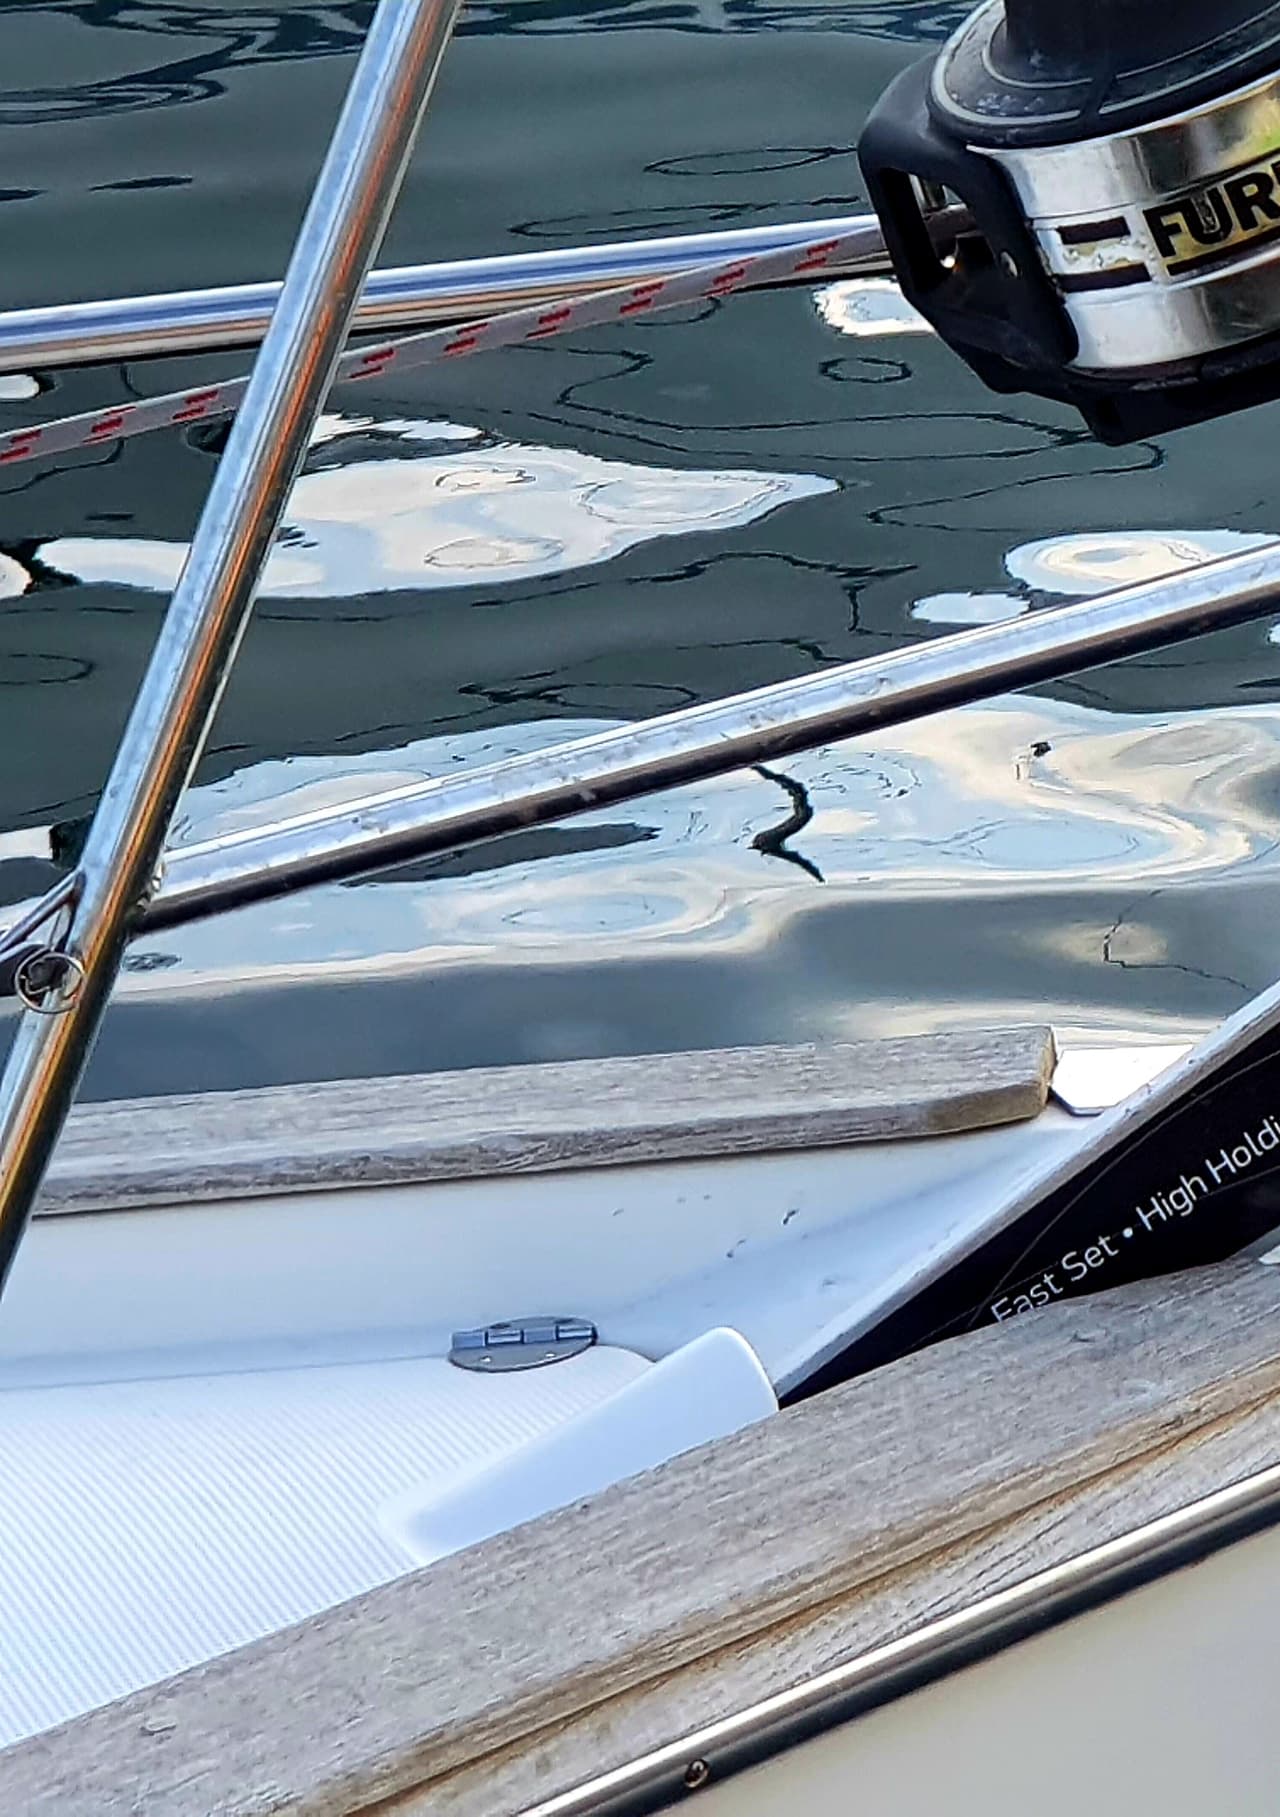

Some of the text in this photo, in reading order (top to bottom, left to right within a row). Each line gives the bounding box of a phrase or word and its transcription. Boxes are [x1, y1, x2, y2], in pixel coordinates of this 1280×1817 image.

[990, 1273, 1064, 1321] Fast
[1061, 1236, 1119, 1281] Set
[1136, 1176, 1208, 1231] High
